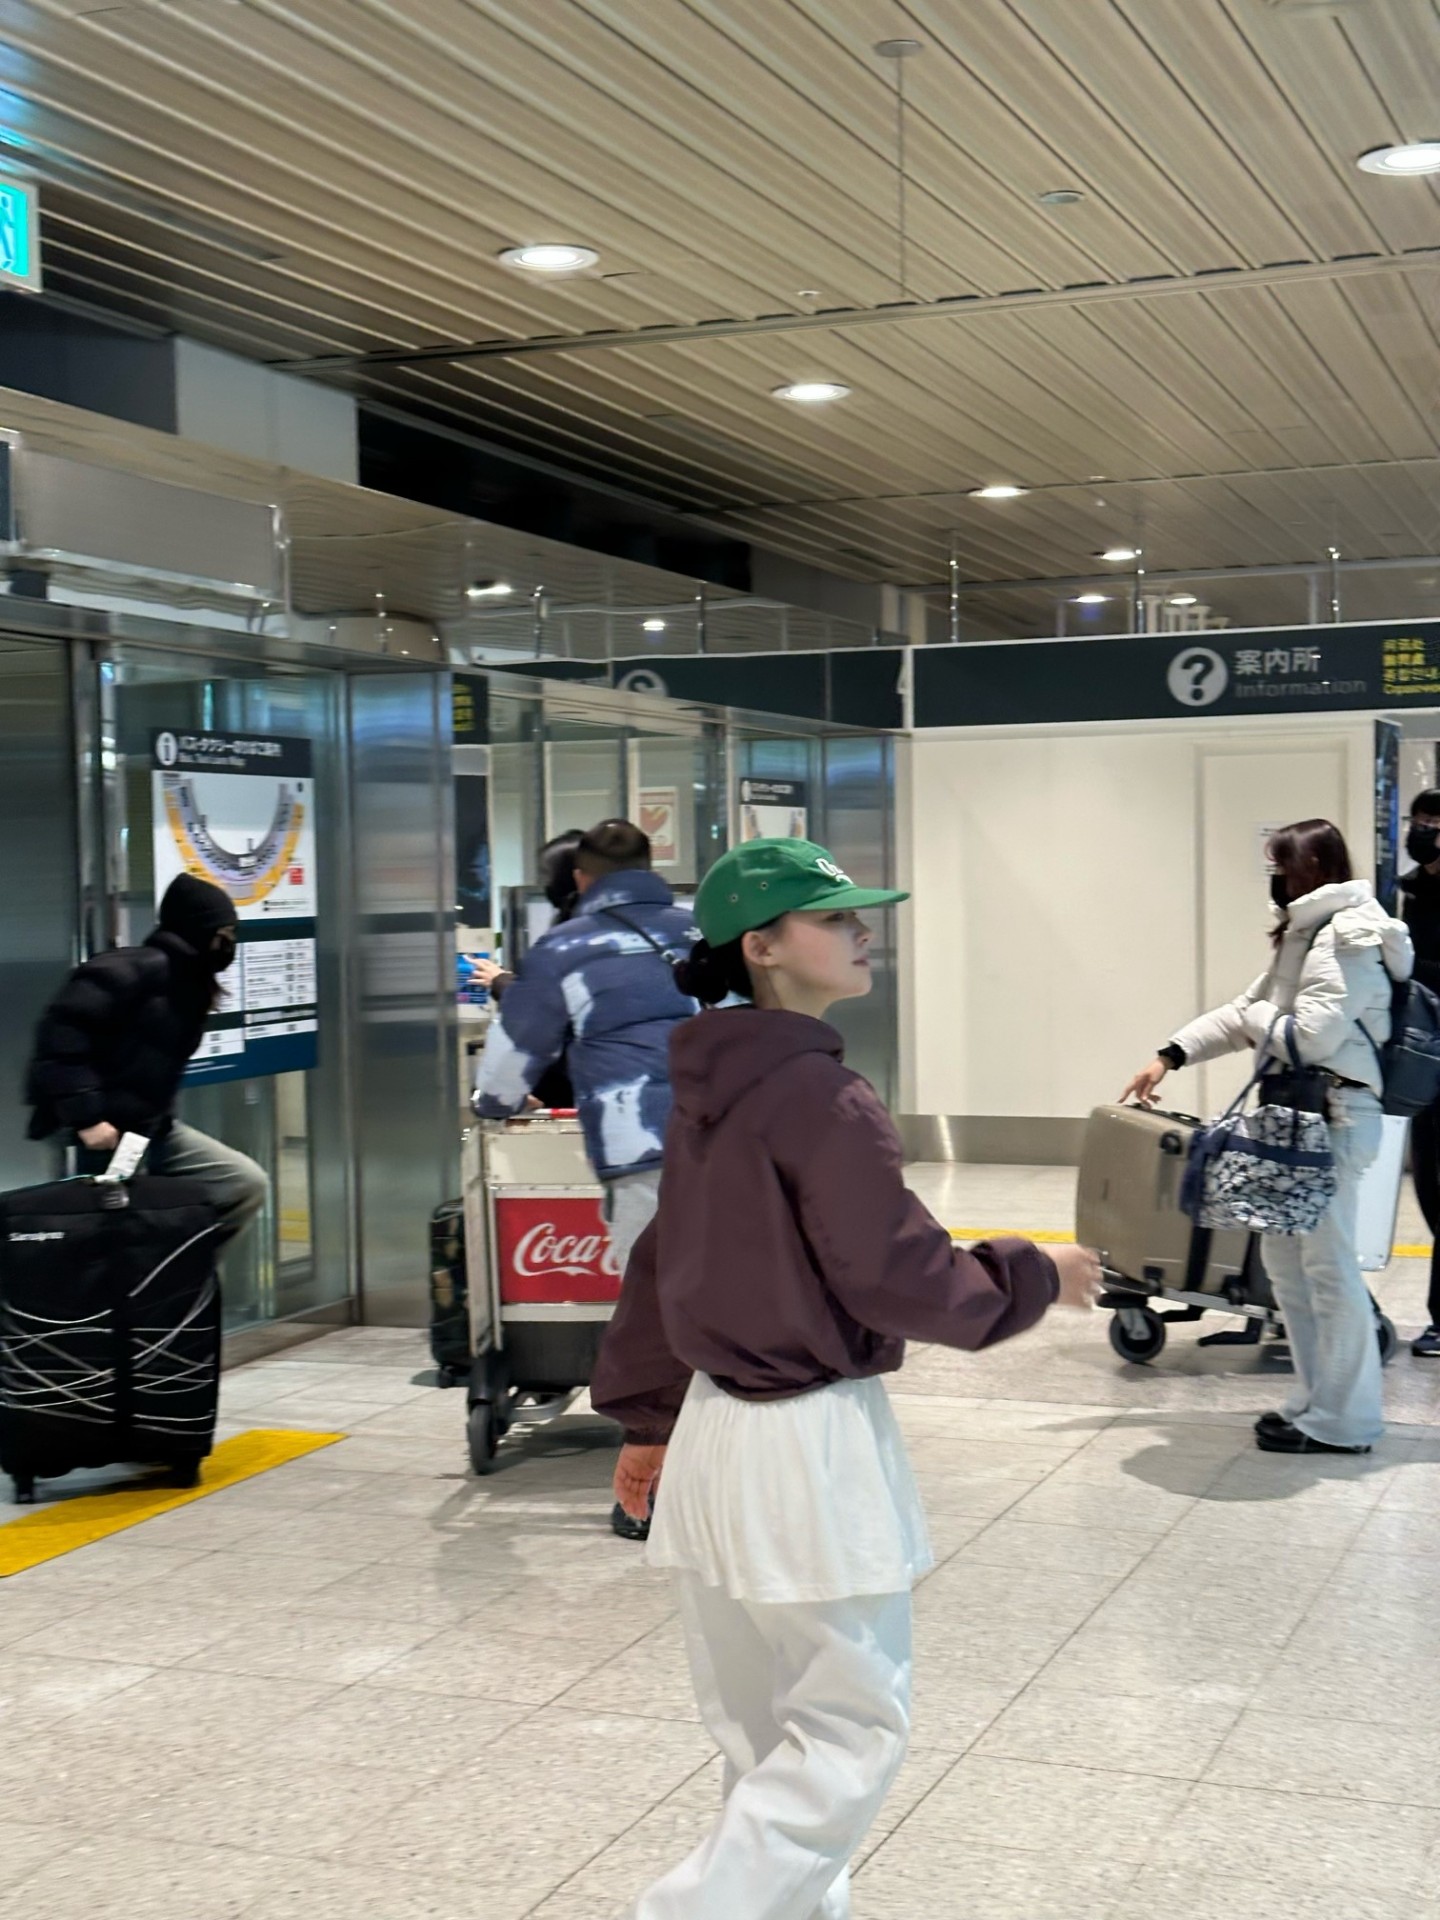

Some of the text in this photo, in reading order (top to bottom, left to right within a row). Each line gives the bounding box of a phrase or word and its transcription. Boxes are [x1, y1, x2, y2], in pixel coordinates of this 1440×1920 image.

[1234, 646, 1320, 676] 案内所
[1235, 680, 1367, 698] Information
